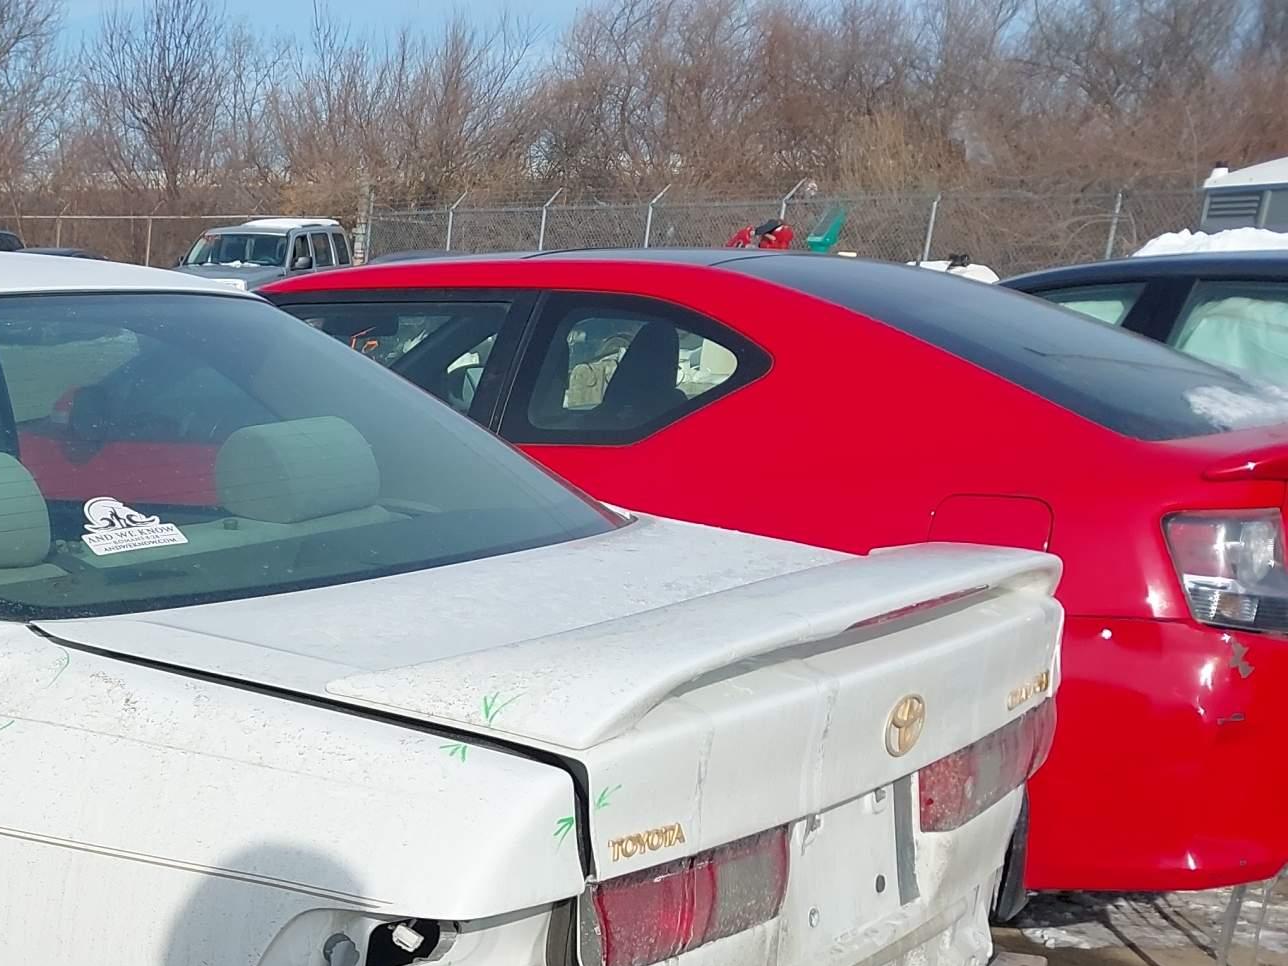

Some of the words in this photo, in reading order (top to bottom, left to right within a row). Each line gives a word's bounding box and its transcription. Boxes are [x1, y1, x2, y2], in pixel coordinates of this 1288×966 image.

[88, 534, 113, 544] AND
[115, 529, 136, 539] WE
[137, 526, 175, 536] KNOW
[608, 822, 686, 862] TOYOTA
